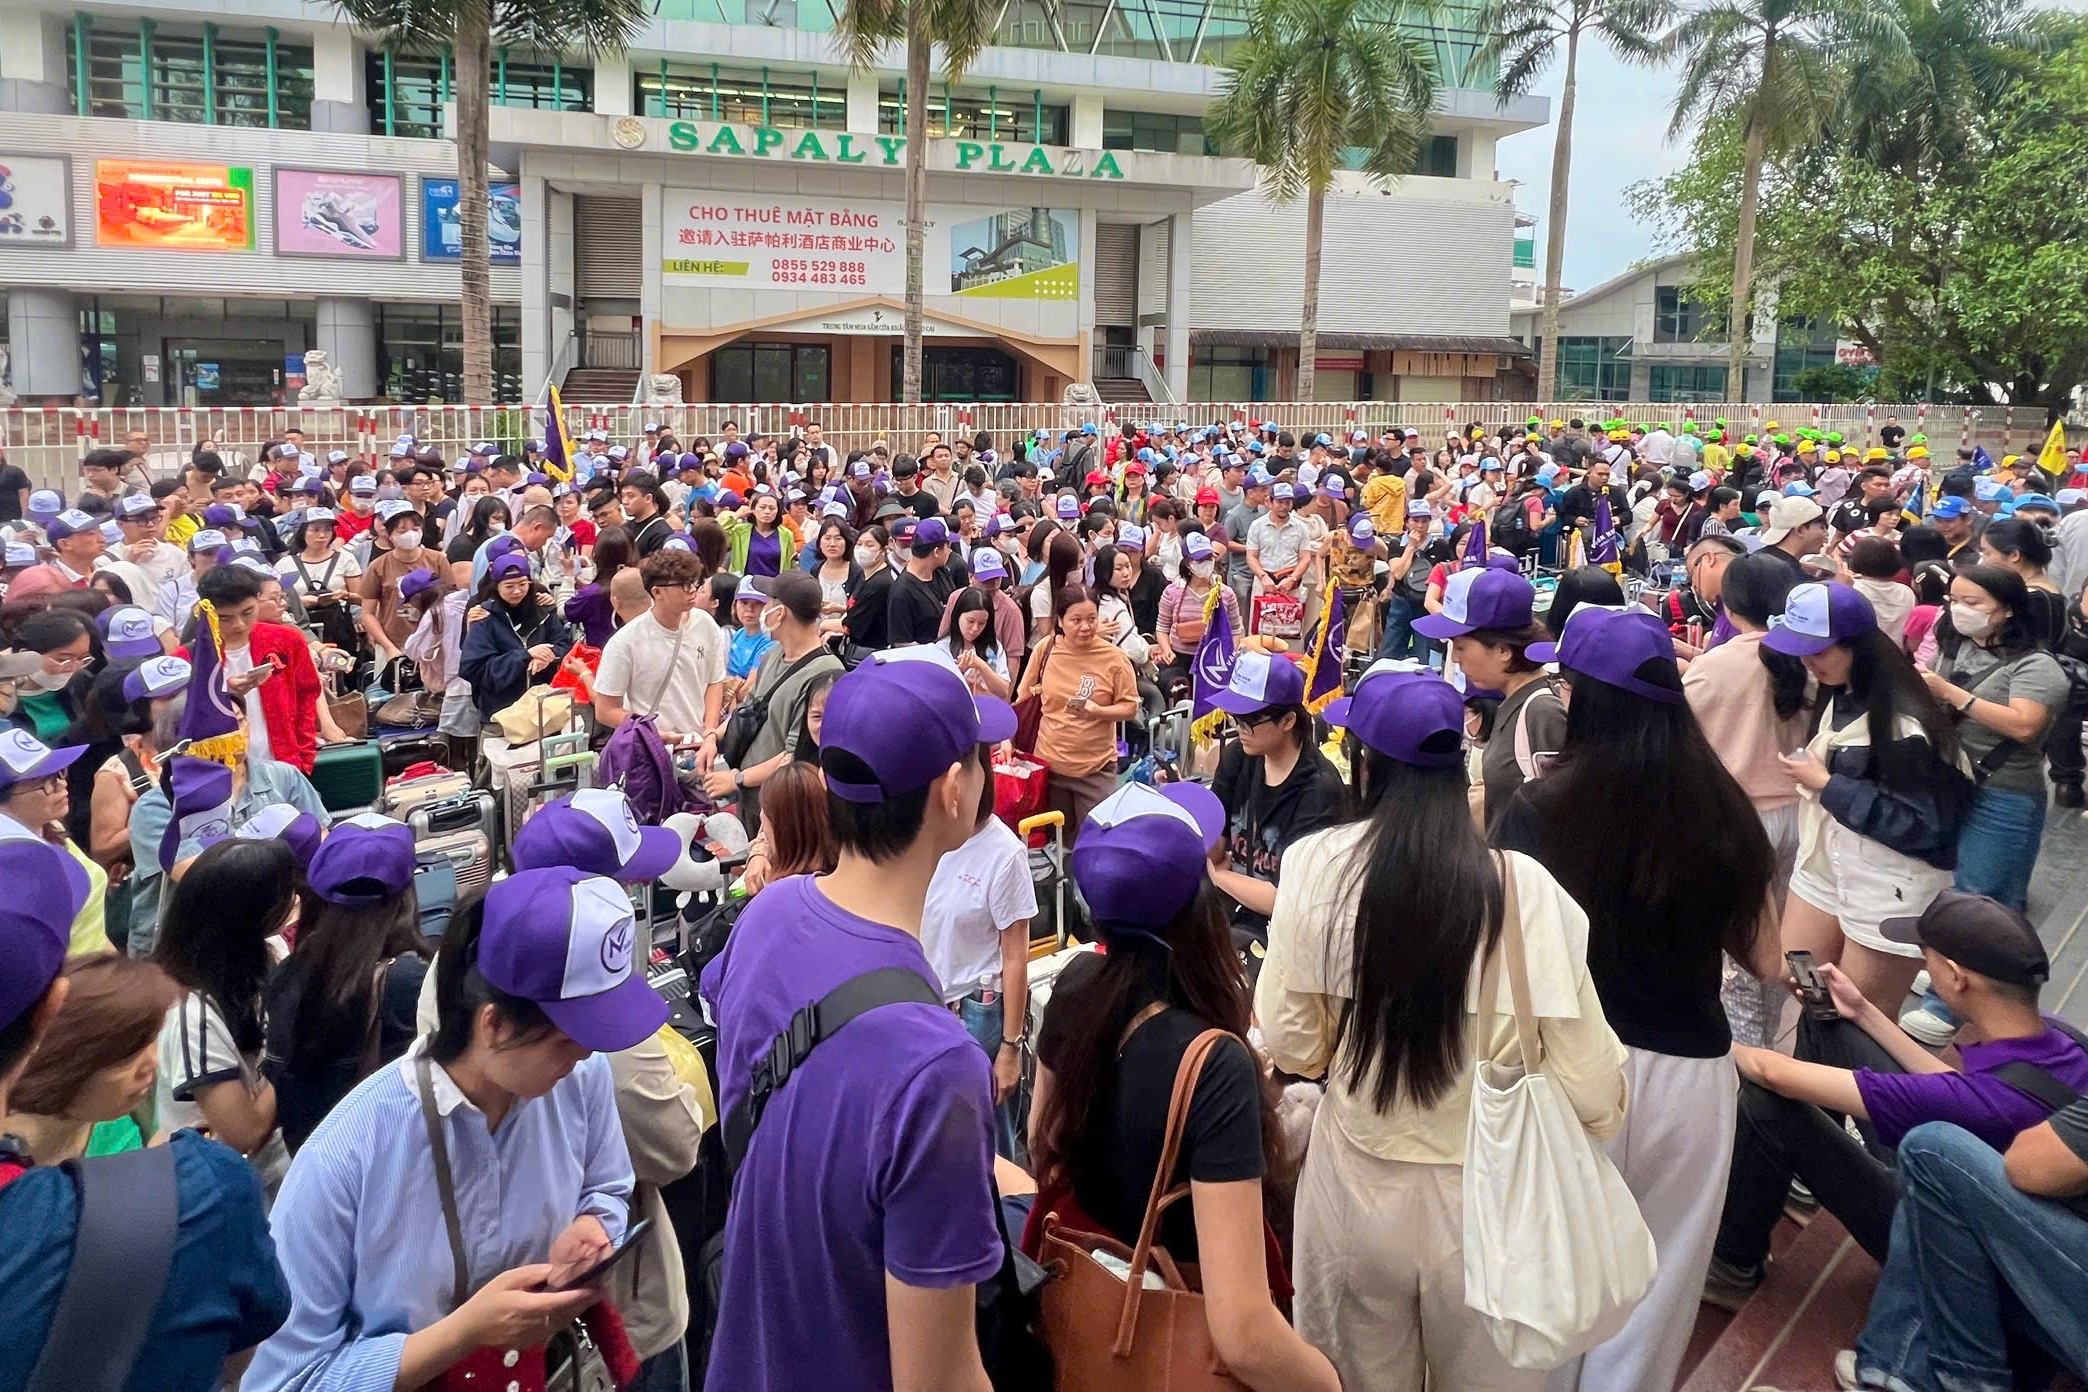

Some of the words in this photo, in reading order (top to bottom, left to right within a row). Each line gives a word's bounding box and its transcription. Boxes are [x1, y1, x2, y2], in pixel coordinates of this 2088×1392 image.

[668, 121, 908, 165] SAPALY
[955, 142, 1124, 179] PLAZA
[689, 206, 728, 221] CHO
[734, 206, 781, 224] THUÊ
[787, 207, 825, 228] MẶT
[829, 208, 878, 228] BẰNG
[678, 228, 896, 253] 邀请入驻萨帕利酒店商业中心
[672, 260, 700, 272] LIÊN
[771, 259, 808, 271] 0855
[811, 261, 836, 272] 529
[839, 262, 866, 273] 888
[771, 271, 807, 283] 0934
[810, 272, 836, 284] 483
[839, 273, 866, 285] 465
[1075, 674, 1095, 699] B
